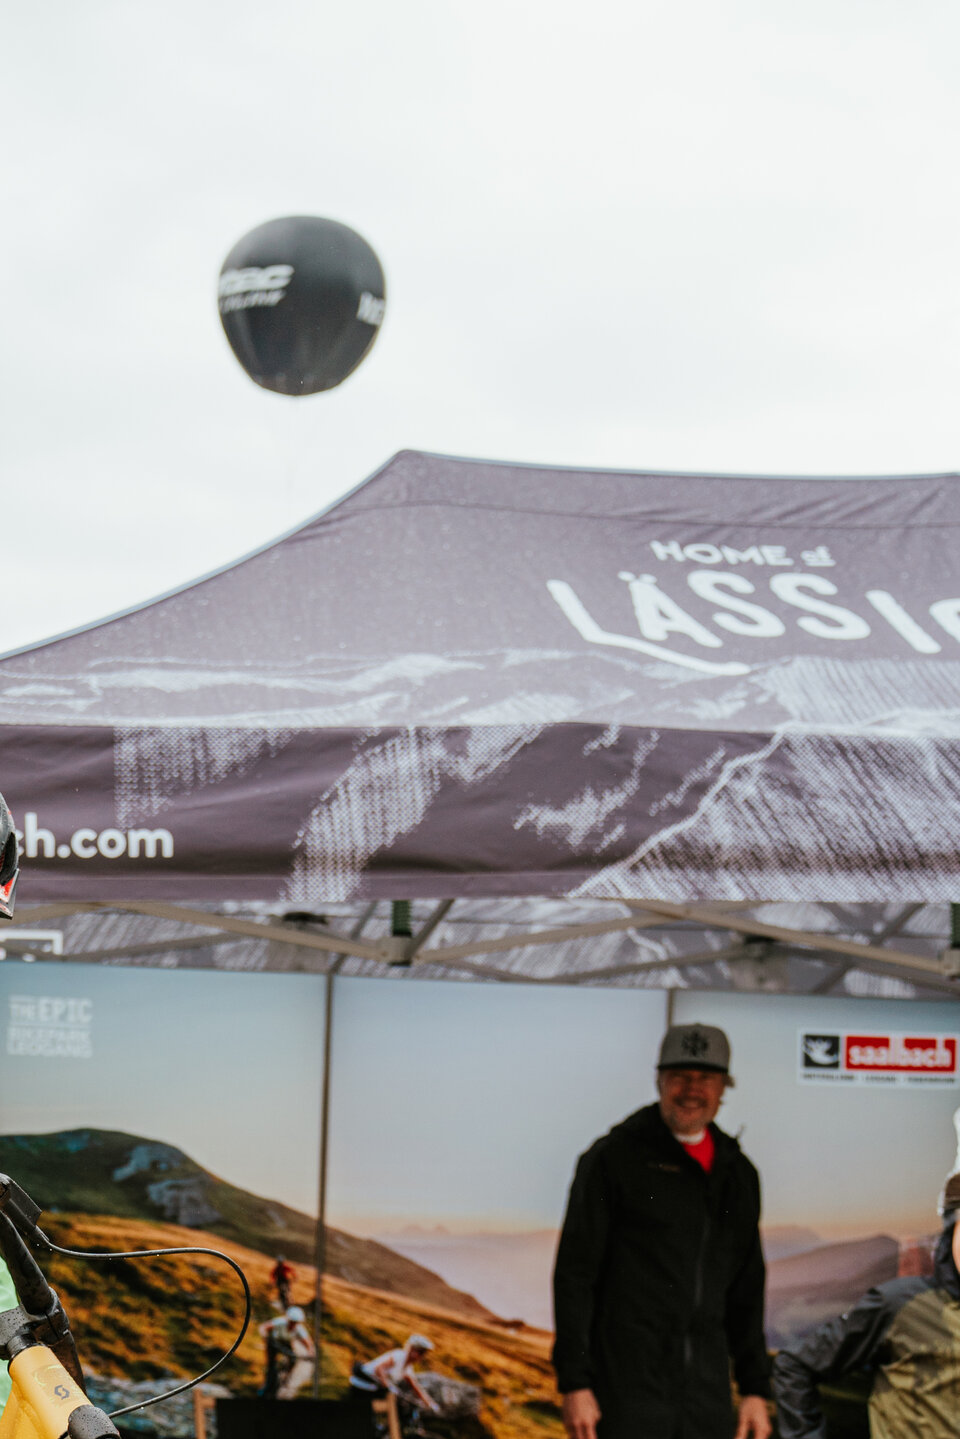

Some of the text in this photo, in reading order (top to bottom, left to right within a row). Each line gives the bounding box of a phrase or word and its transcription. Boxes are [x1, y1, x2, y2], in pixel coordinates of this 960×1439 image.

[649, 540, 795, 566] HOME
[39, 997, 93, 1023] EPIC
[848, 1035, 952, 1068] saalbach
